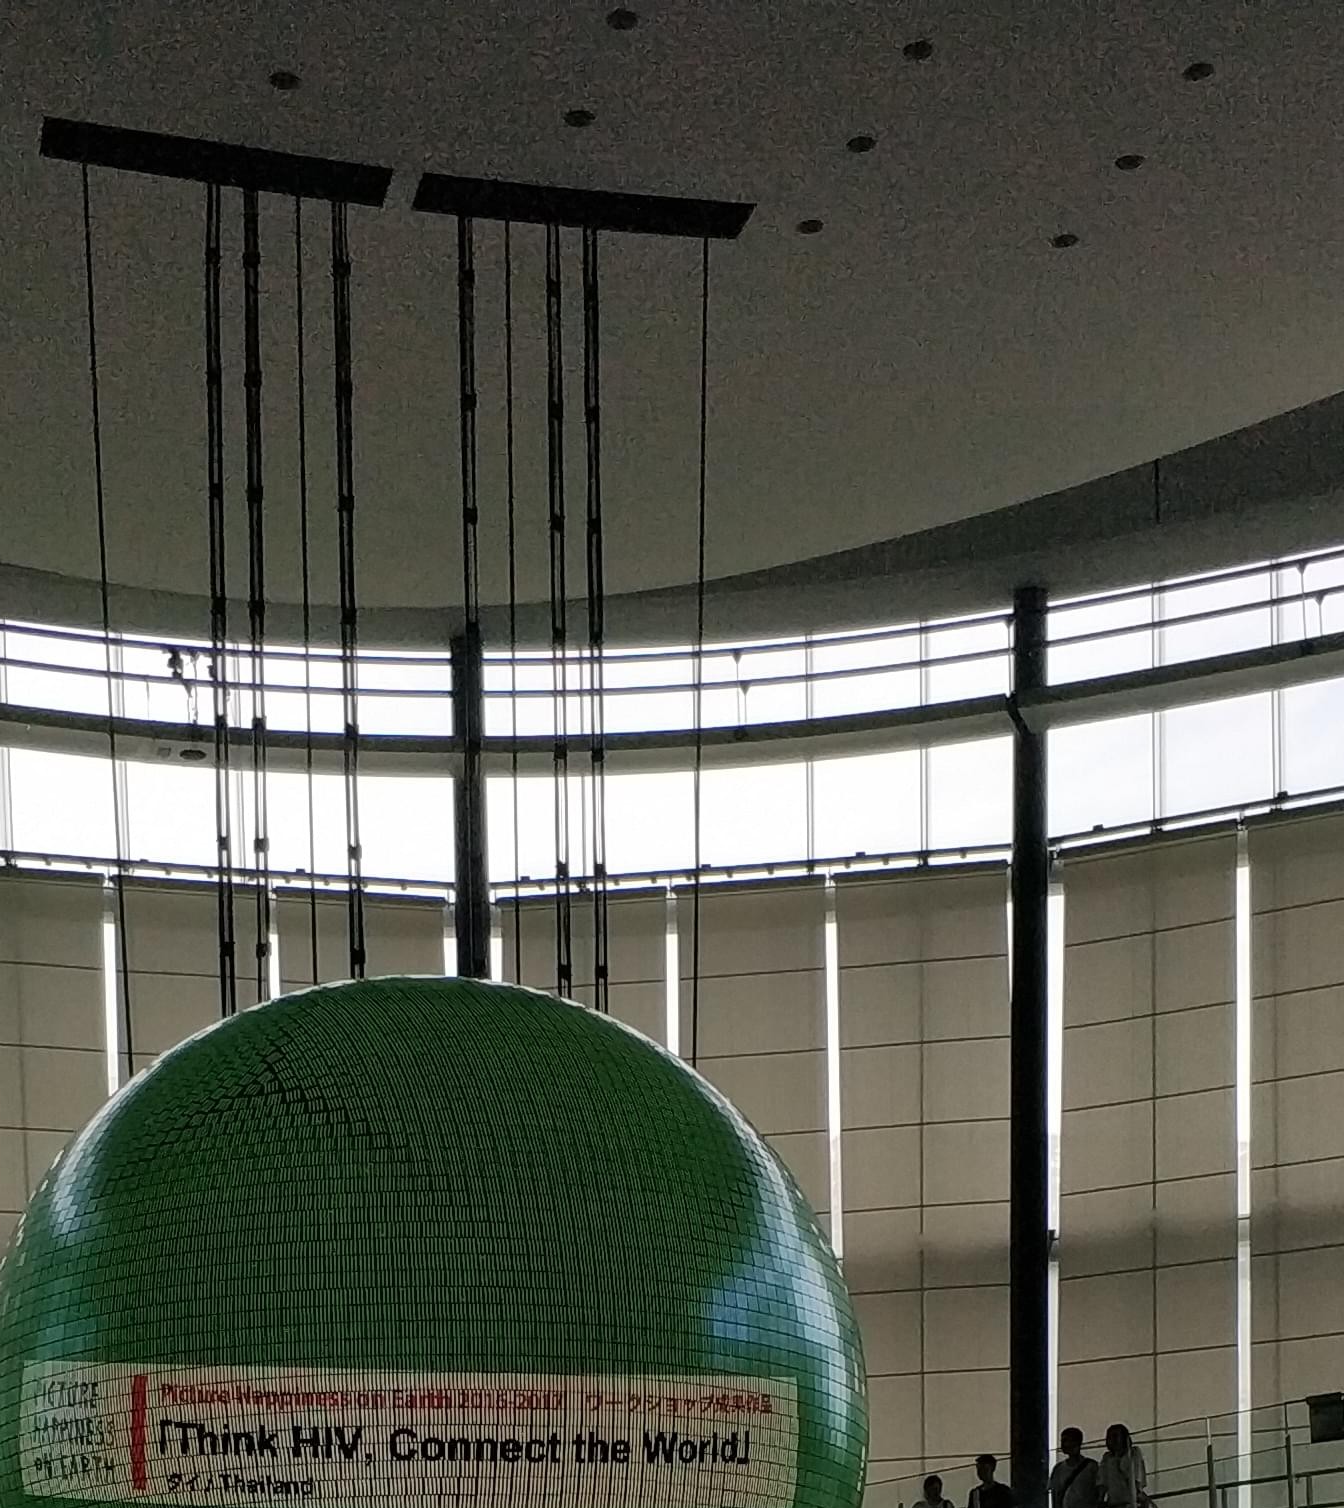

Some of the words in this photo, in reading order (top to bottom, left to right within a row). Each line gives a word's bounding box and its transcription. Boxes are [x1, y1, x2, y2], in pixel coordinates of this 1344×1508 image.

[161, 1383, 228, 1404] Picture
[358, 1392, 385, 1408] on
[394, 1389, 452, 1409] Earth
[291, 1425, 373, 1466] HIV,
[389, 1428, 561, 1464] Connect
[572, 1431, 630, 1464] the
